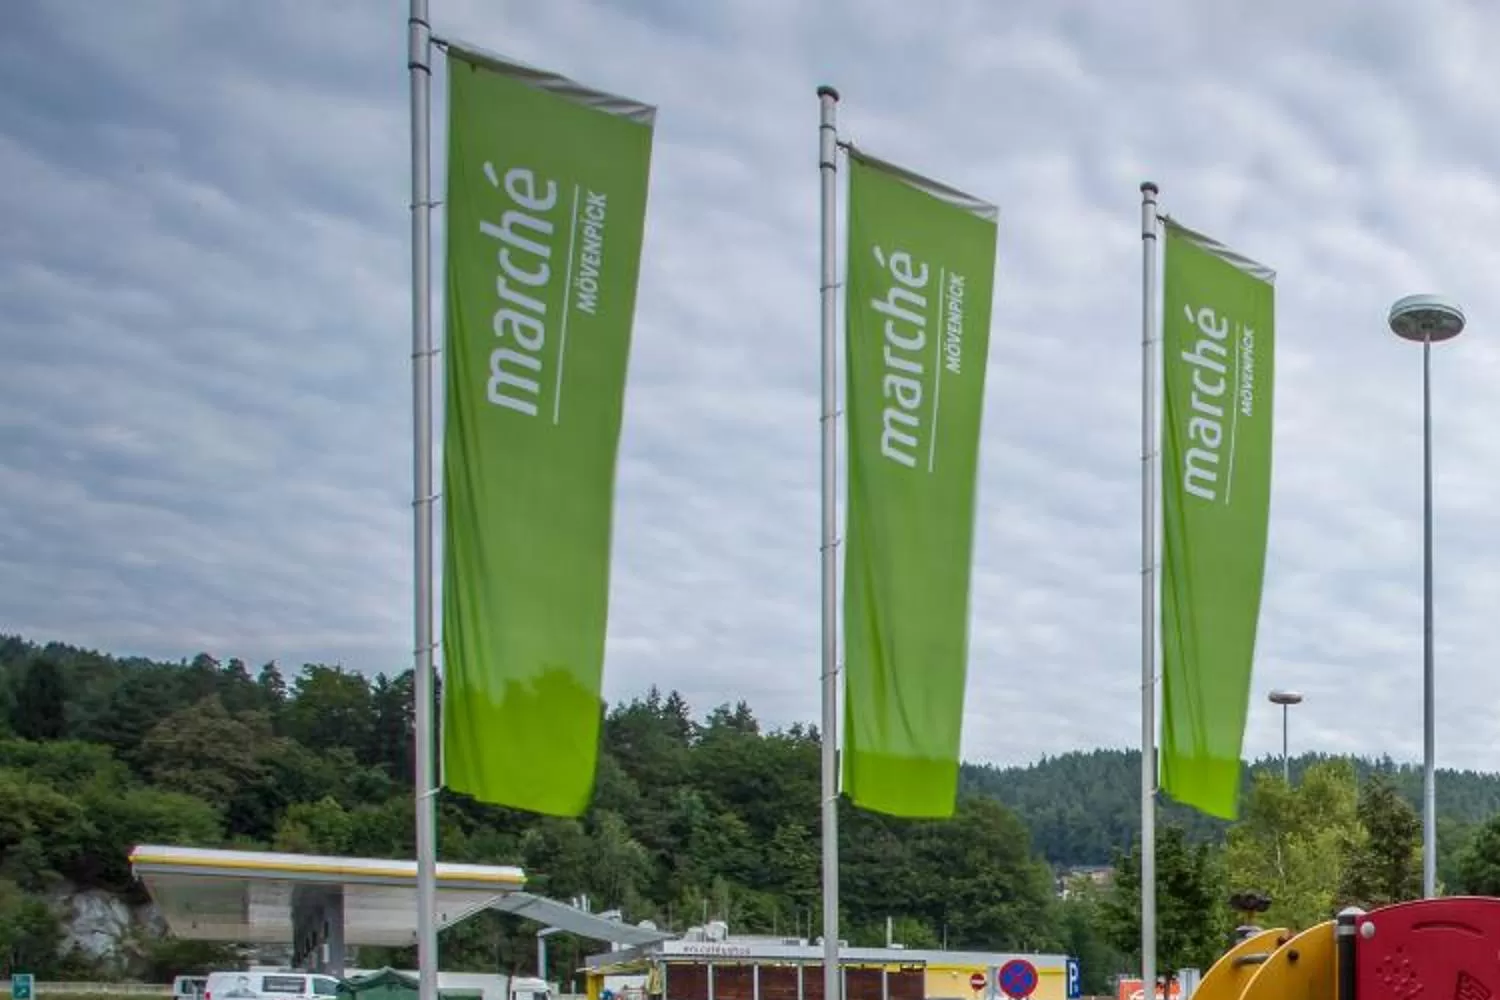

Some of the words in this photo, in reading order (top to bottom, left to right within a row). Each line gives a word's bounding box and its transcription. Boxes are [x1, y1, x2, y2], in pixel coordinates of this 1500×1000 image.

[479, 160, 557, 417] marché
[576, 190, 607, 316] MÖVENPICK
[944, 271, 966, 375] MÖVENPICK
[871, 245, 929, 468] marché
[1181, 303, 1228, 500] marché
